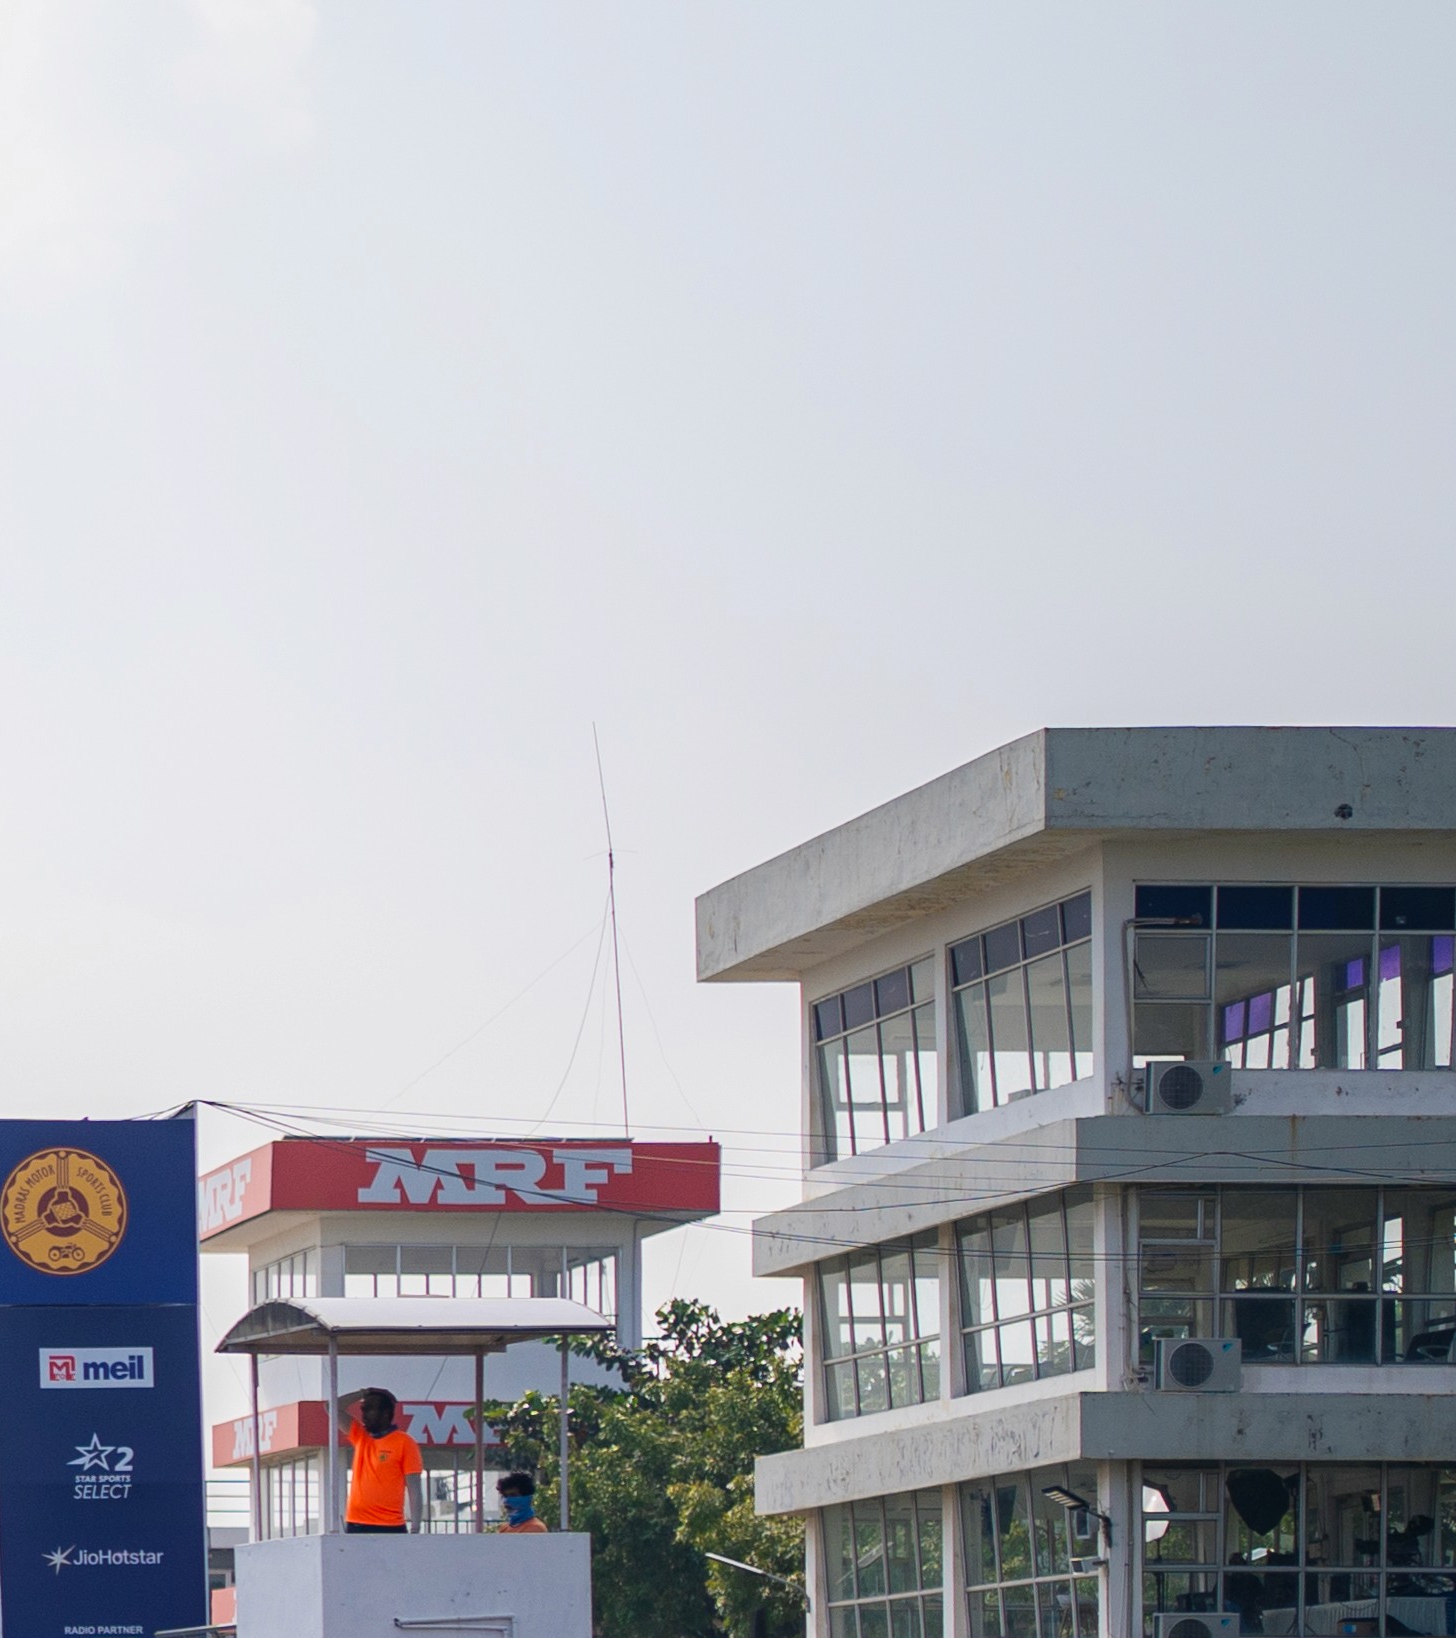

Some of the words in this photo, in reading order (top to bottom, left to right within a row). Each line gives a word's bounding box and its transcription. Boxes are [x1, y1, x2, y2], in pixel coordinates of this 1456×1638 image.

[358, 1147, 633, 1205] MRF
[14, 1186, 30, 1224] MADRAS
[25, 1164, 56, 1188] MOTOR
[76, 1166, 105, 1194] SPORTS
[99, 1193, 112, 1216] CLUB
[83, 1355, 144, 1380] meil
[114, 1446, 134, 1472] 2
[75, 1475, 96, 1483] STAR
[99, 1475, 131, 1483] SPORTS
[73, 1484, 132, 1500] SELECT
[73, 1549, 164, 1566] JioHotstar
[64, 1626, 96, 1635] RADIO
[97, 1626, 144, 1635] PARTNER
